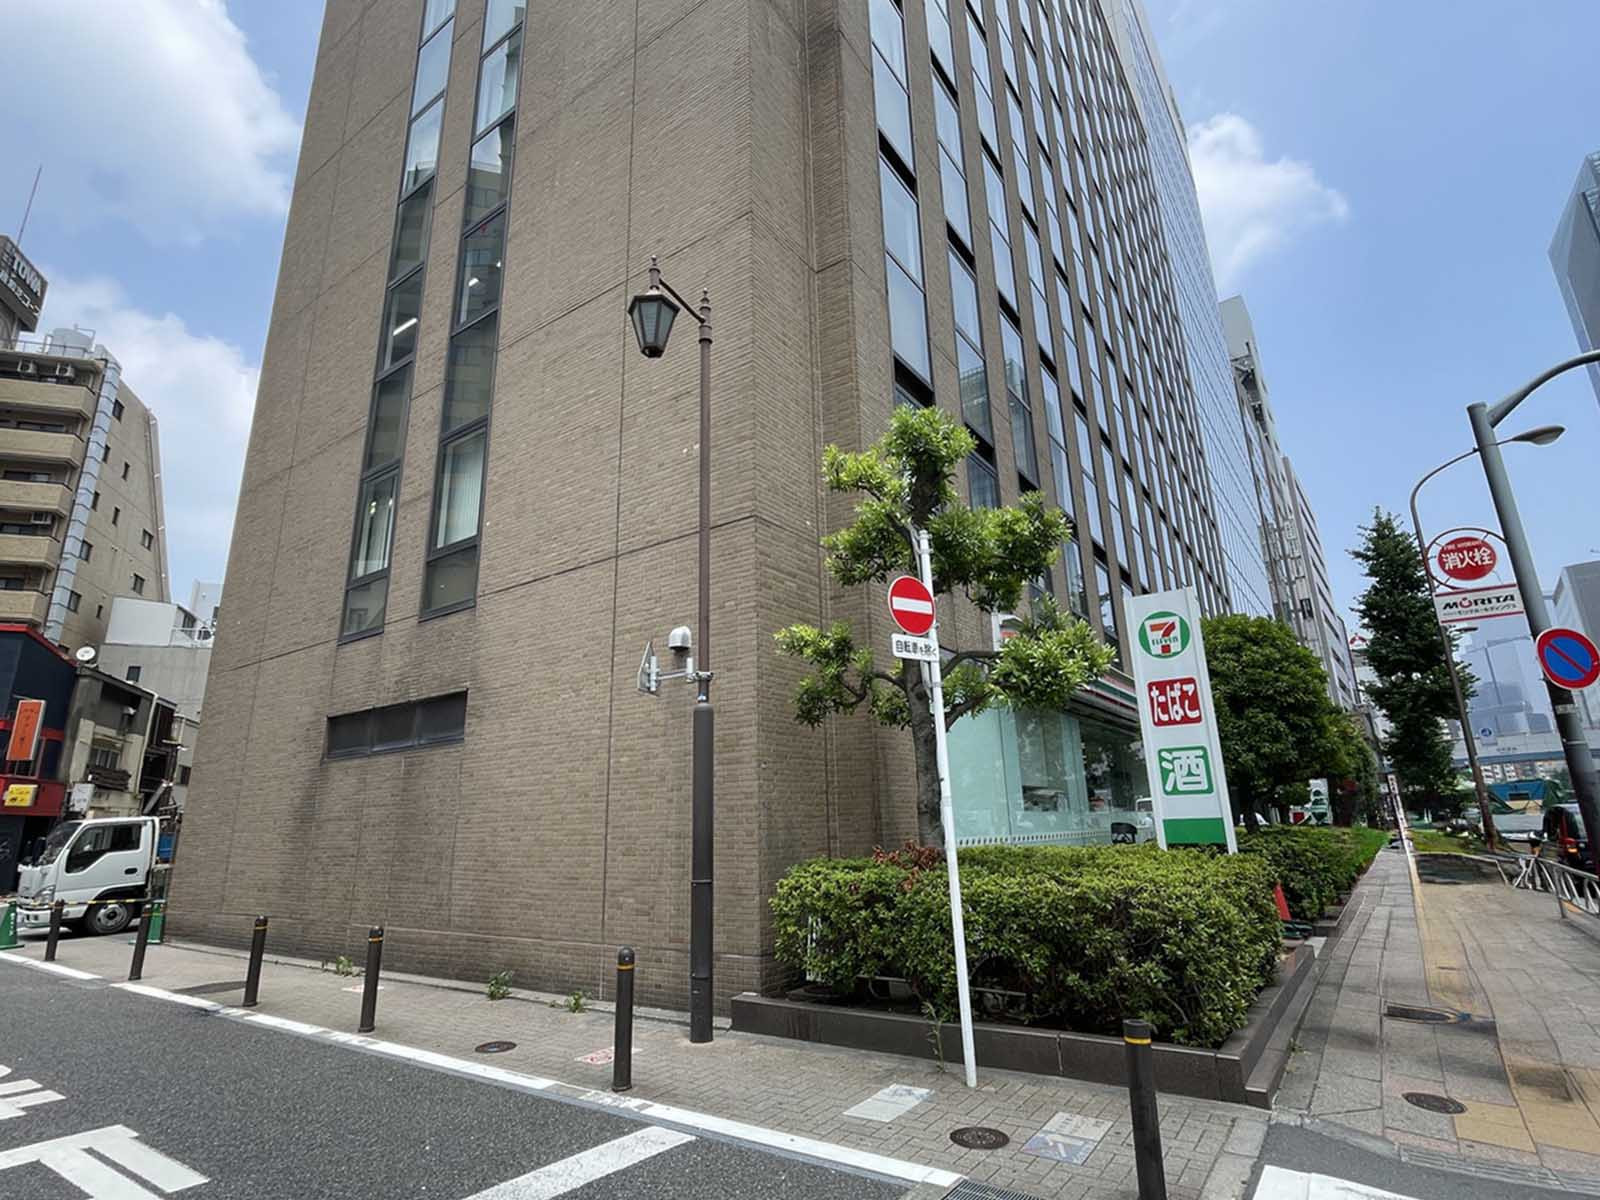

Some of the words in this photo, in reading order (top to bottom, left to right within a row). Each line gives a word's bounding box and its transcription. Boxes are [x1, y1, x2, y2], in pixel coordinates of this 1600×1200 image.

[1441, 547, 1494, 570] 消火栓
[1442, 594, 1516, 610] MORITA
[896, 640, 937, 656] 自転車を除く
[1150, 682, 1201, 722] たばこ
[1161, 751, 1209, 792] 酒
